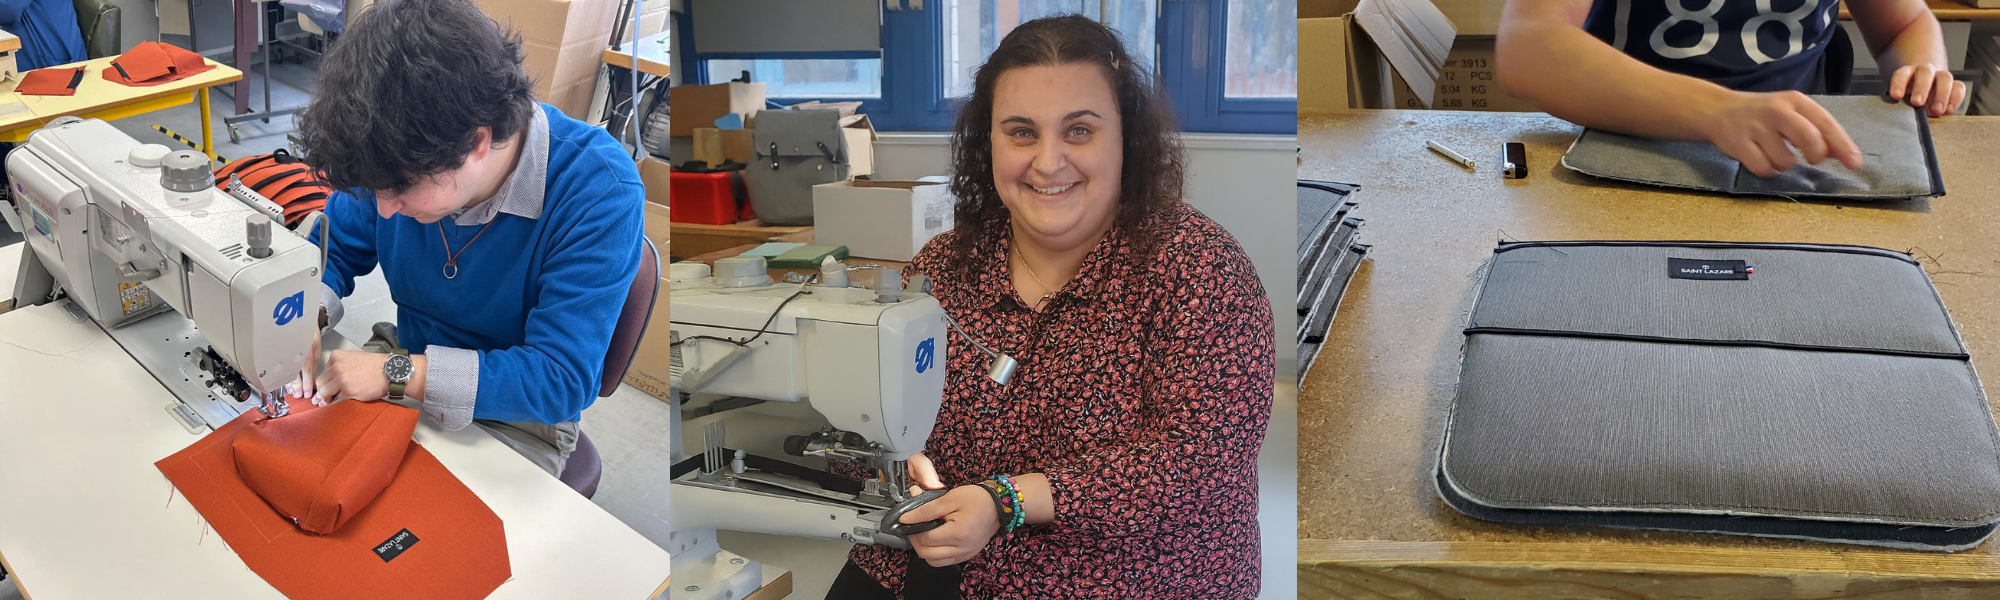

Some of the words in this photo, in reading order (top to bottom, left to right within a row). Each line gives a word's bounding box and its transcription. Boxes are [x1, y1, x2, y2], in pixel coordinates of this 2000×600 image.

[1461, 59, 1487, 68] 3913
[1444, 71, 1455, 80] 12
[1470, 71, 1493, 81] PCS
[1441, 85, 1460, 94] 5.04
[1471, 85, 1487, 94] KG
[1442, 99, 1462, 108] 5.88
[1471, 99, 1487, 108] KG
[394, 531, 409, 544] SAINT
[377, 540, 397, 554] LAZARE
